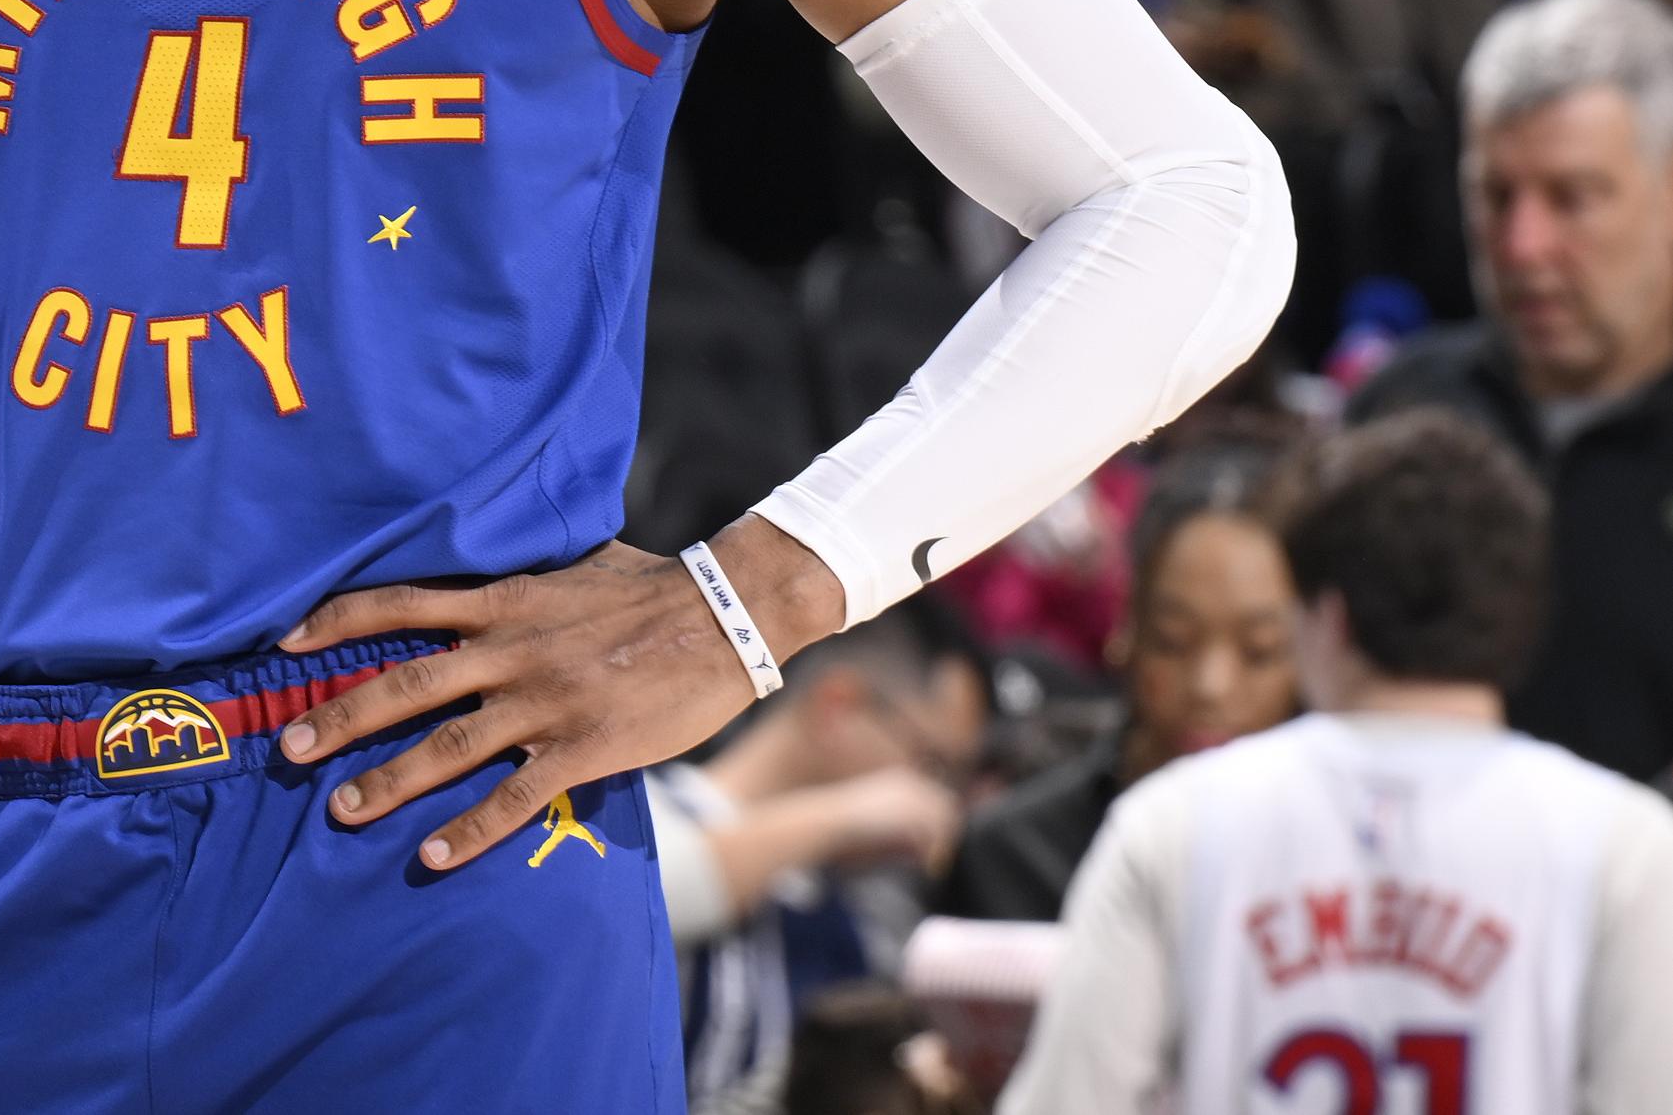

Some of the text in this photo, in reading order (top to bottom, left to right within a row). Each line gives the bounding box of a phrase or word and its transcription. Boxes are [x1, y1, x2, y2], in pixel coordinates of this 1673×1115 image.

[114, 15, 251, 251] 4
[9, 284, 307, 439] CITY
[711, 584, 732, 611] WHY
